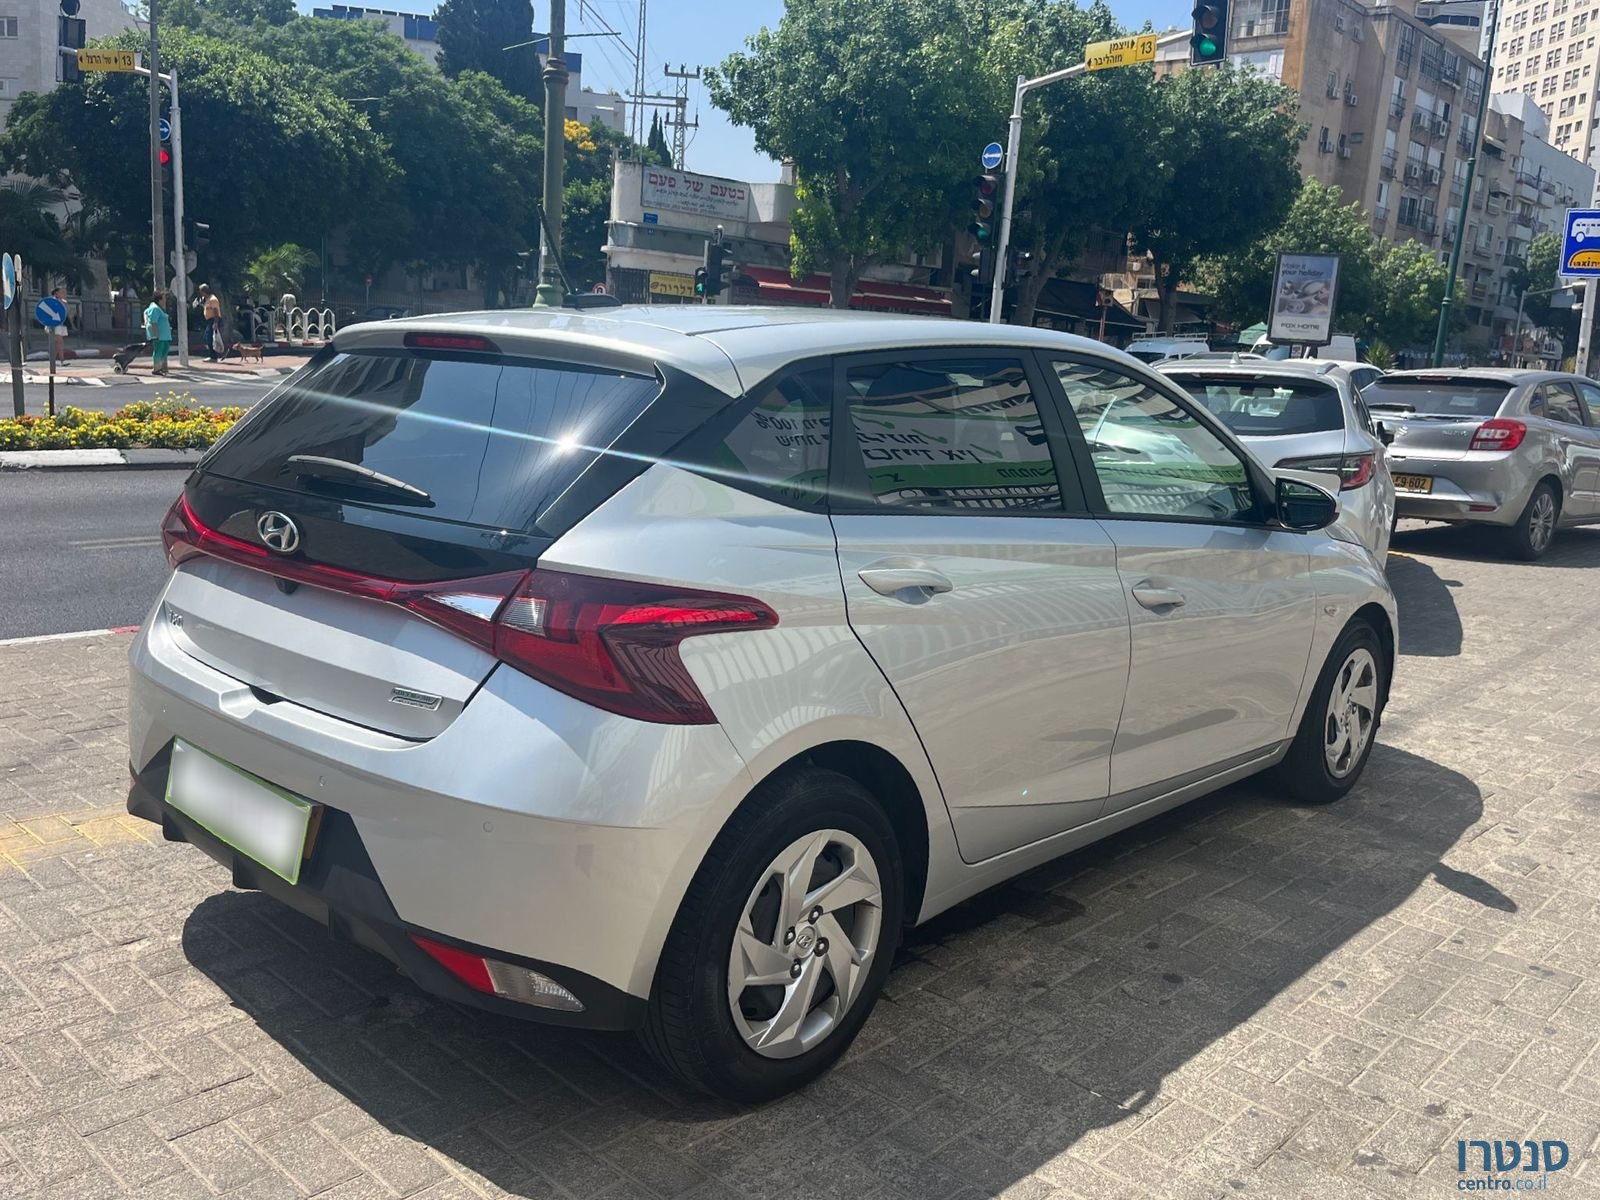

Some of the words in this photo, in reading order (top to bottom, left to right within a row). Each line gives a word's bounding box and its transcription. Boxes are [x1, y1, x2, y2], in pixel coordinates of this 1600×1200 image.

[1109, 41, 1130, 54] ויצמן
[1141, 41, 1153, 54] 13
[122, 55, 132, 66] 13
[1094, 54, 1123, 66] מוהליבר
[648, 172, 676, 188] פעם
[683, 175, 704, 192] של
[710, 184, 745, 200] בטעם
